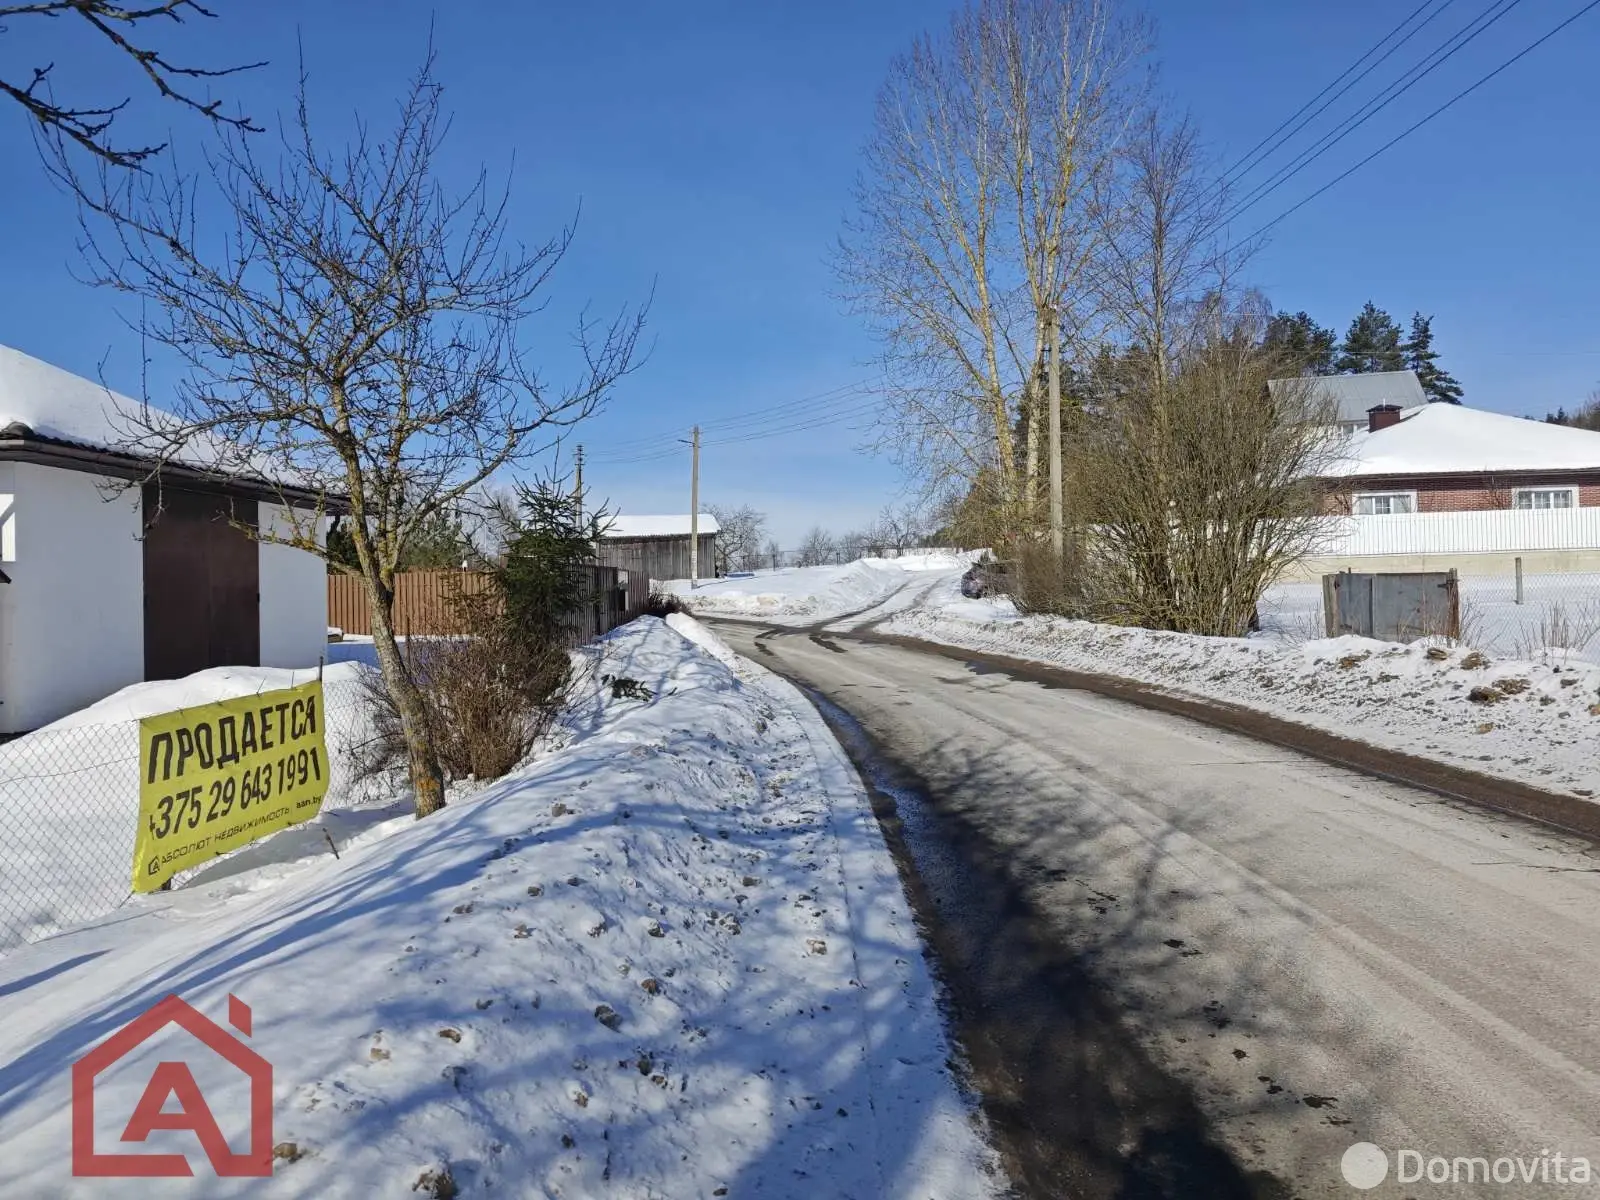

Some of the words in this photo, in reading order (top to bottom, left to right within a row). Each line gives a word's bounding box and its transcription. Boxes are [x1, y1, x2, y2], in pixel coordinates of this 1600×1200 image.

[147, 695, 316, 784] ПРОДАЕТСЯ
[206, 776, 235, 823] 29
[240, 761, 272, 810] 643
[278, 746, 321, 796] 1991
[161, 837, 212, 864] АБСОЛЮТ
[214, 807, 290, 841] НЕДВИЖИМОСТЬ
[296, 795, 322, 809] aan.by
